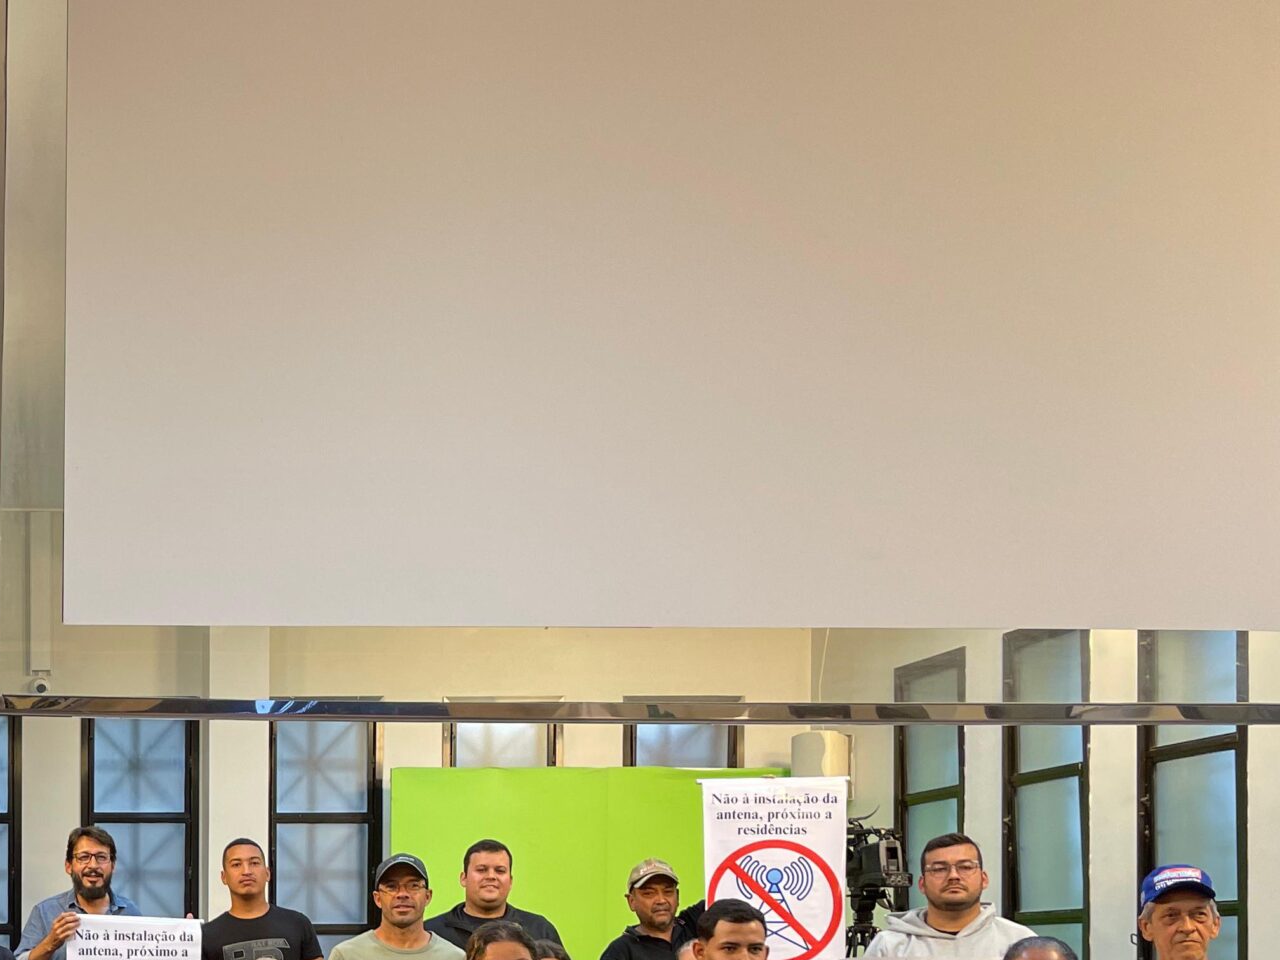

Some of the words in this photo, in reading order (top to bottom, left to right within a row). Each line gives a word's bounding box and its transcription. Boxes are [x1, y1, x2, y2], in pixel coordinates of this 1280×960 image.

[712, 793, 738, 804] Não
[742, 793, 750, 804] à
[822, 793, 838, 804] da
[716, 810, 763, 821] antena,
[767, 808, 821, 822] próximo
[825, 811, 832, 819] a
[737, 824, 807, 835] residências
[74, 929, 99, 940] Não
[103, 930, 110, 940] à
[114, 930, 176, 943] instalação
[179, 931, 194, 942] da
[78, 947, 123, 958] antena,
[127, 946, 178, 959] próximo
[181, 949, 188, 957] a
